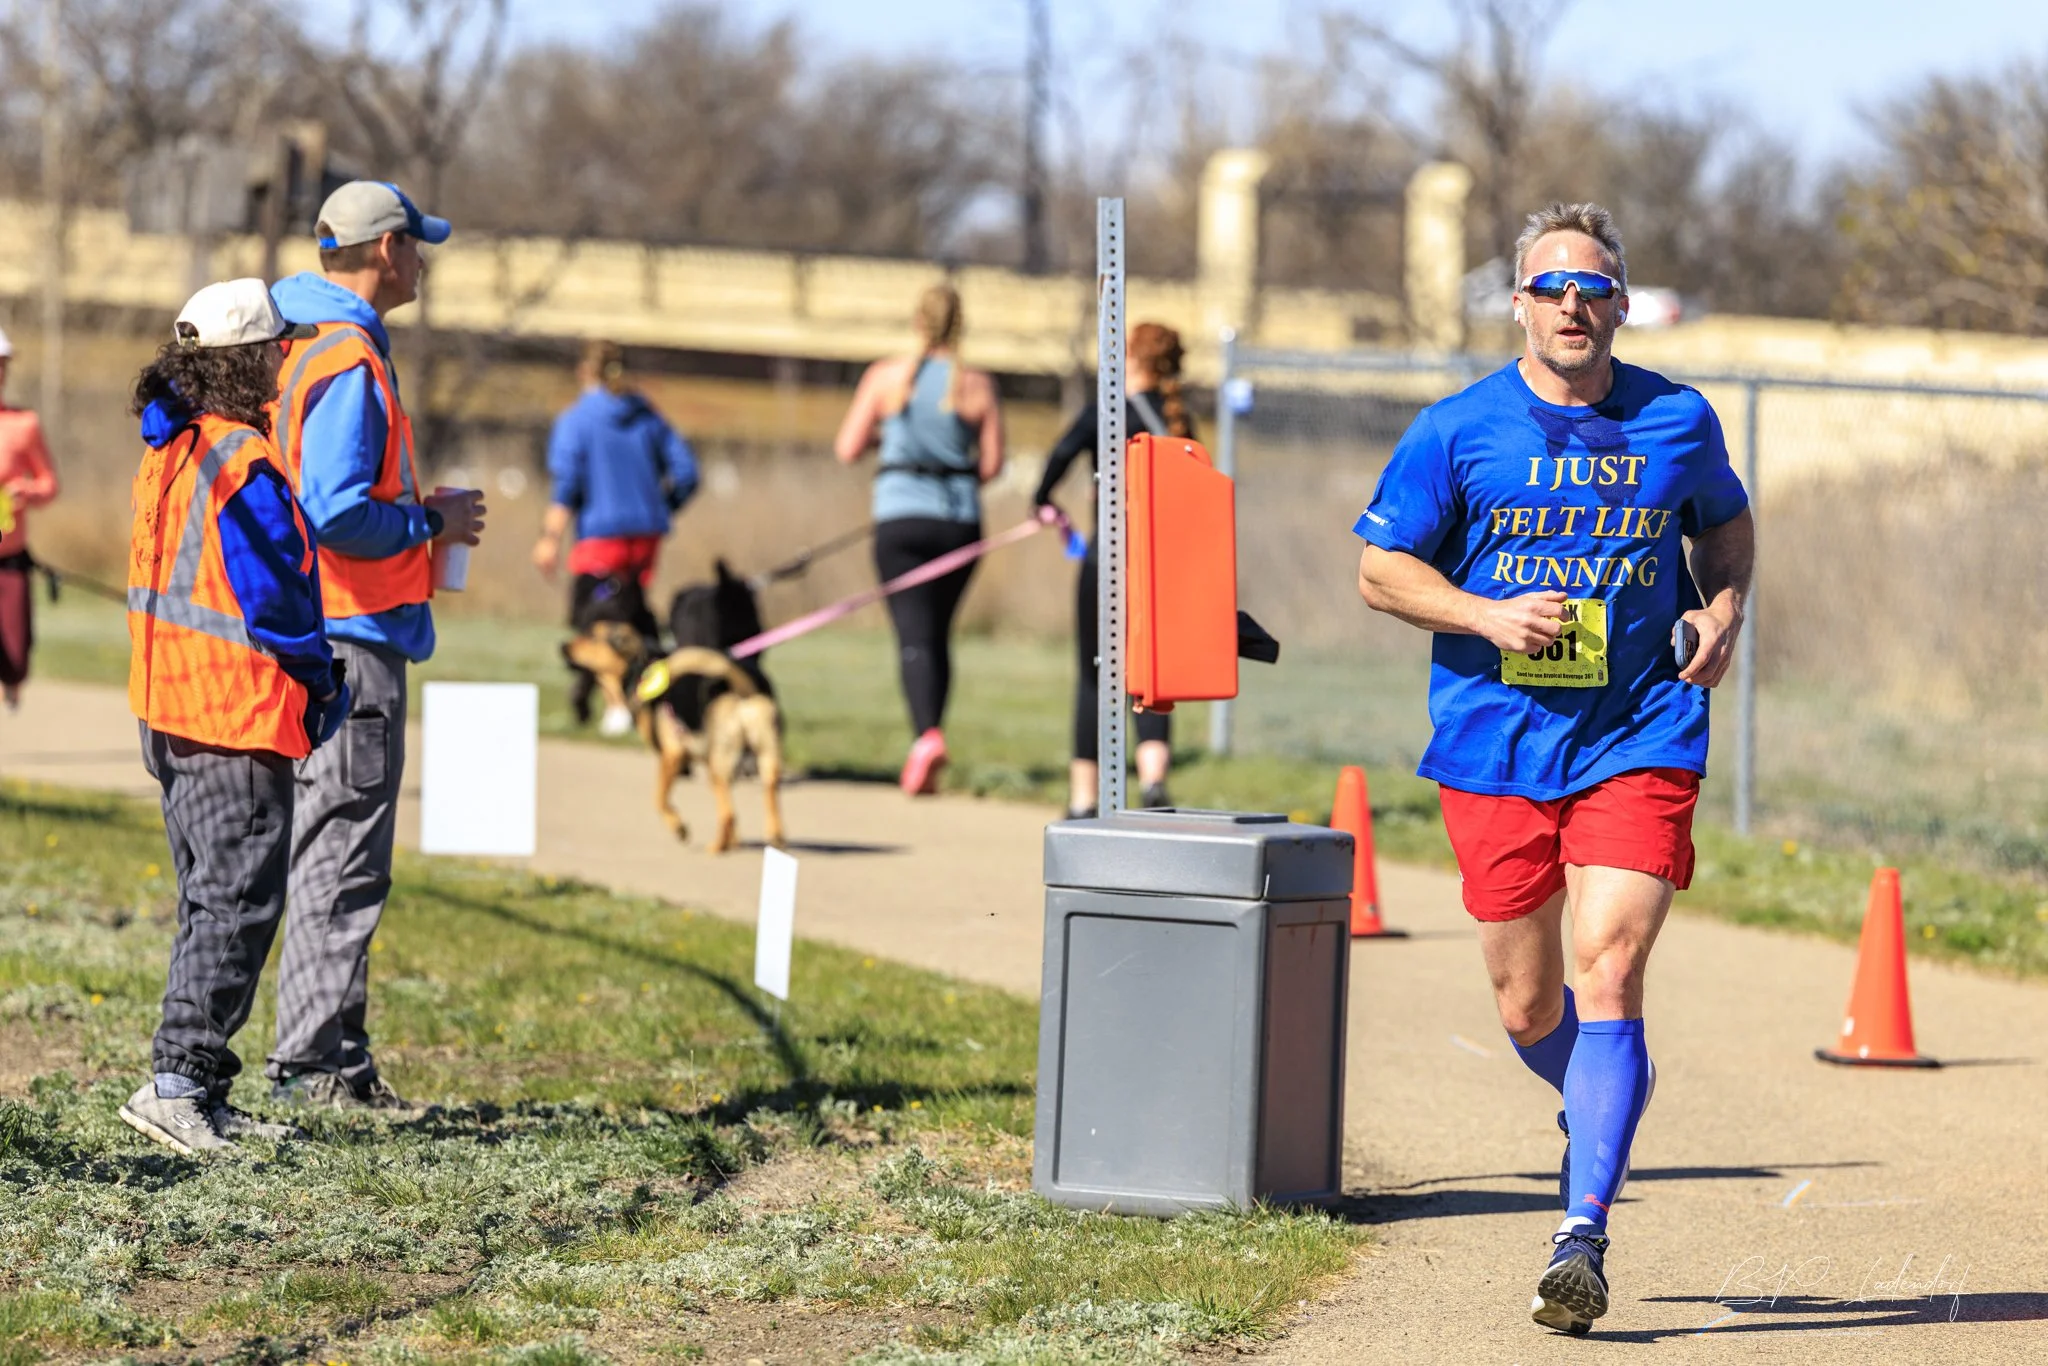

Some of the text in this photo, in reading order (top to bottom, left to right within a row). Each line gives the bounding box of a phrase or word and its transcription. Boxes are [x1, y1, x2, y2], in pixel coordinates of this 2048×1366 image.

[1525, 455, 1646, 491] I JUST
[1490, 506, 1673, 539] FELT LIKE
[1491, 551, 1659, 588] RUNNING
